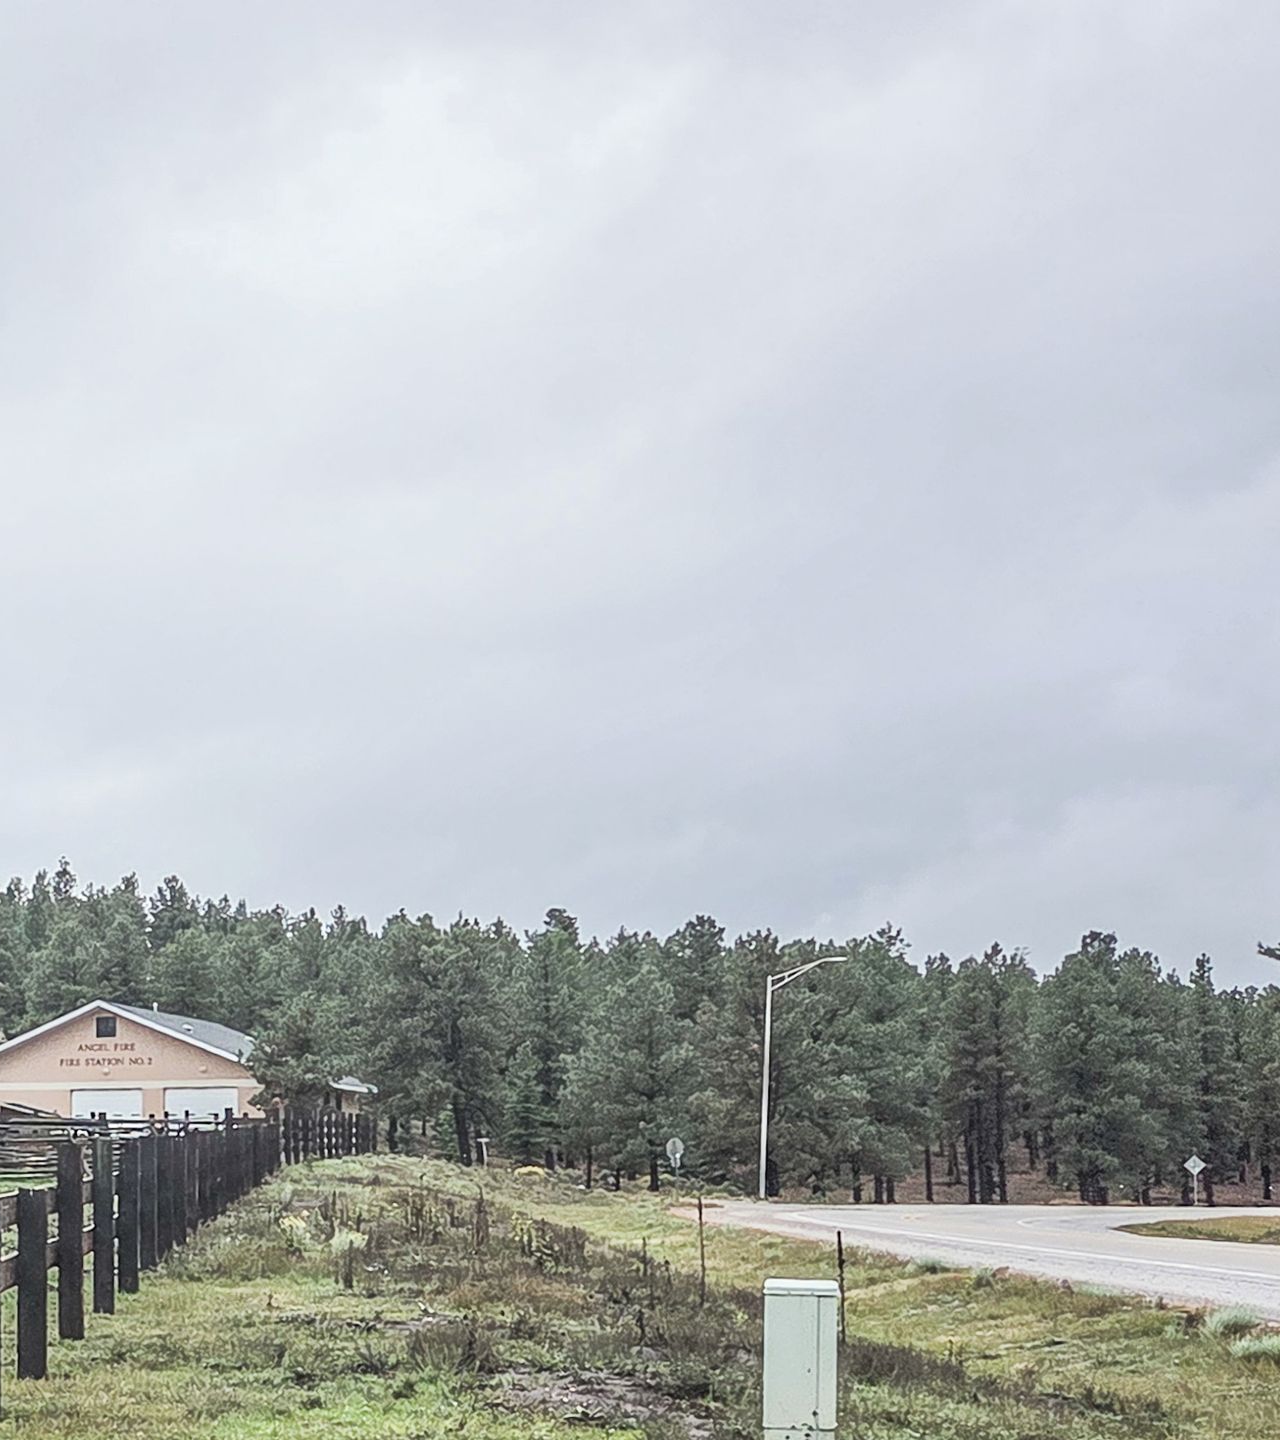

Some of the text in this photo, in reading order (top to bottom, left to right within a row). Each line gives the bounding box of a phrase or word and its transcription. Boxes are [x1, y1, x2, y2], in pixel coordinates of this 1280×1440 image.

[114, 1042, 136, 1052] FIRE
[59, 1058, 81, 1066] FIRE
[85, 1057, 124, 1066] STATION
